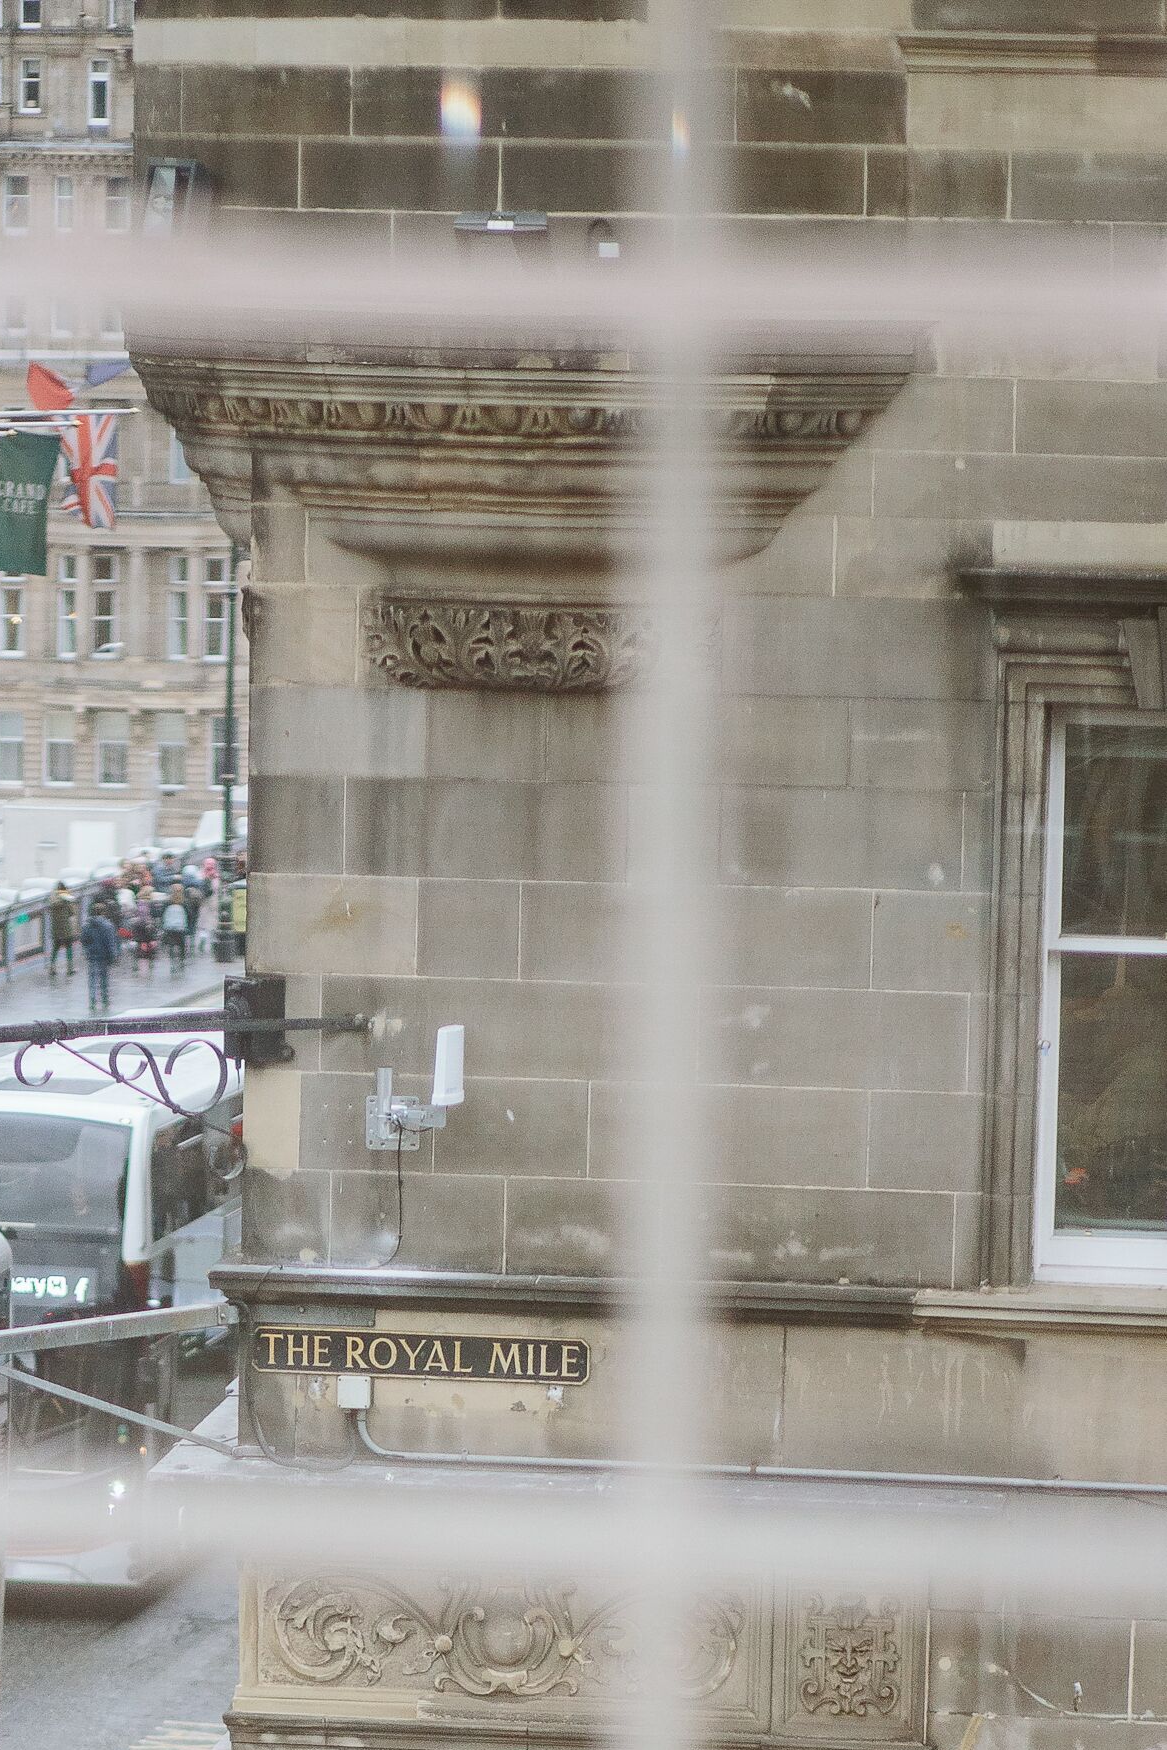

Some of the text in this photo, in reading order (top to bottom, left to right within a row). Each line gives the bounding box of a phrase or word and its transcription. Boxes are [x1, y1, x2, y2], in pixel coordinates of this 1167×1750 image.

[260, 1333, 581, 1378] THE ROYAL MILE
